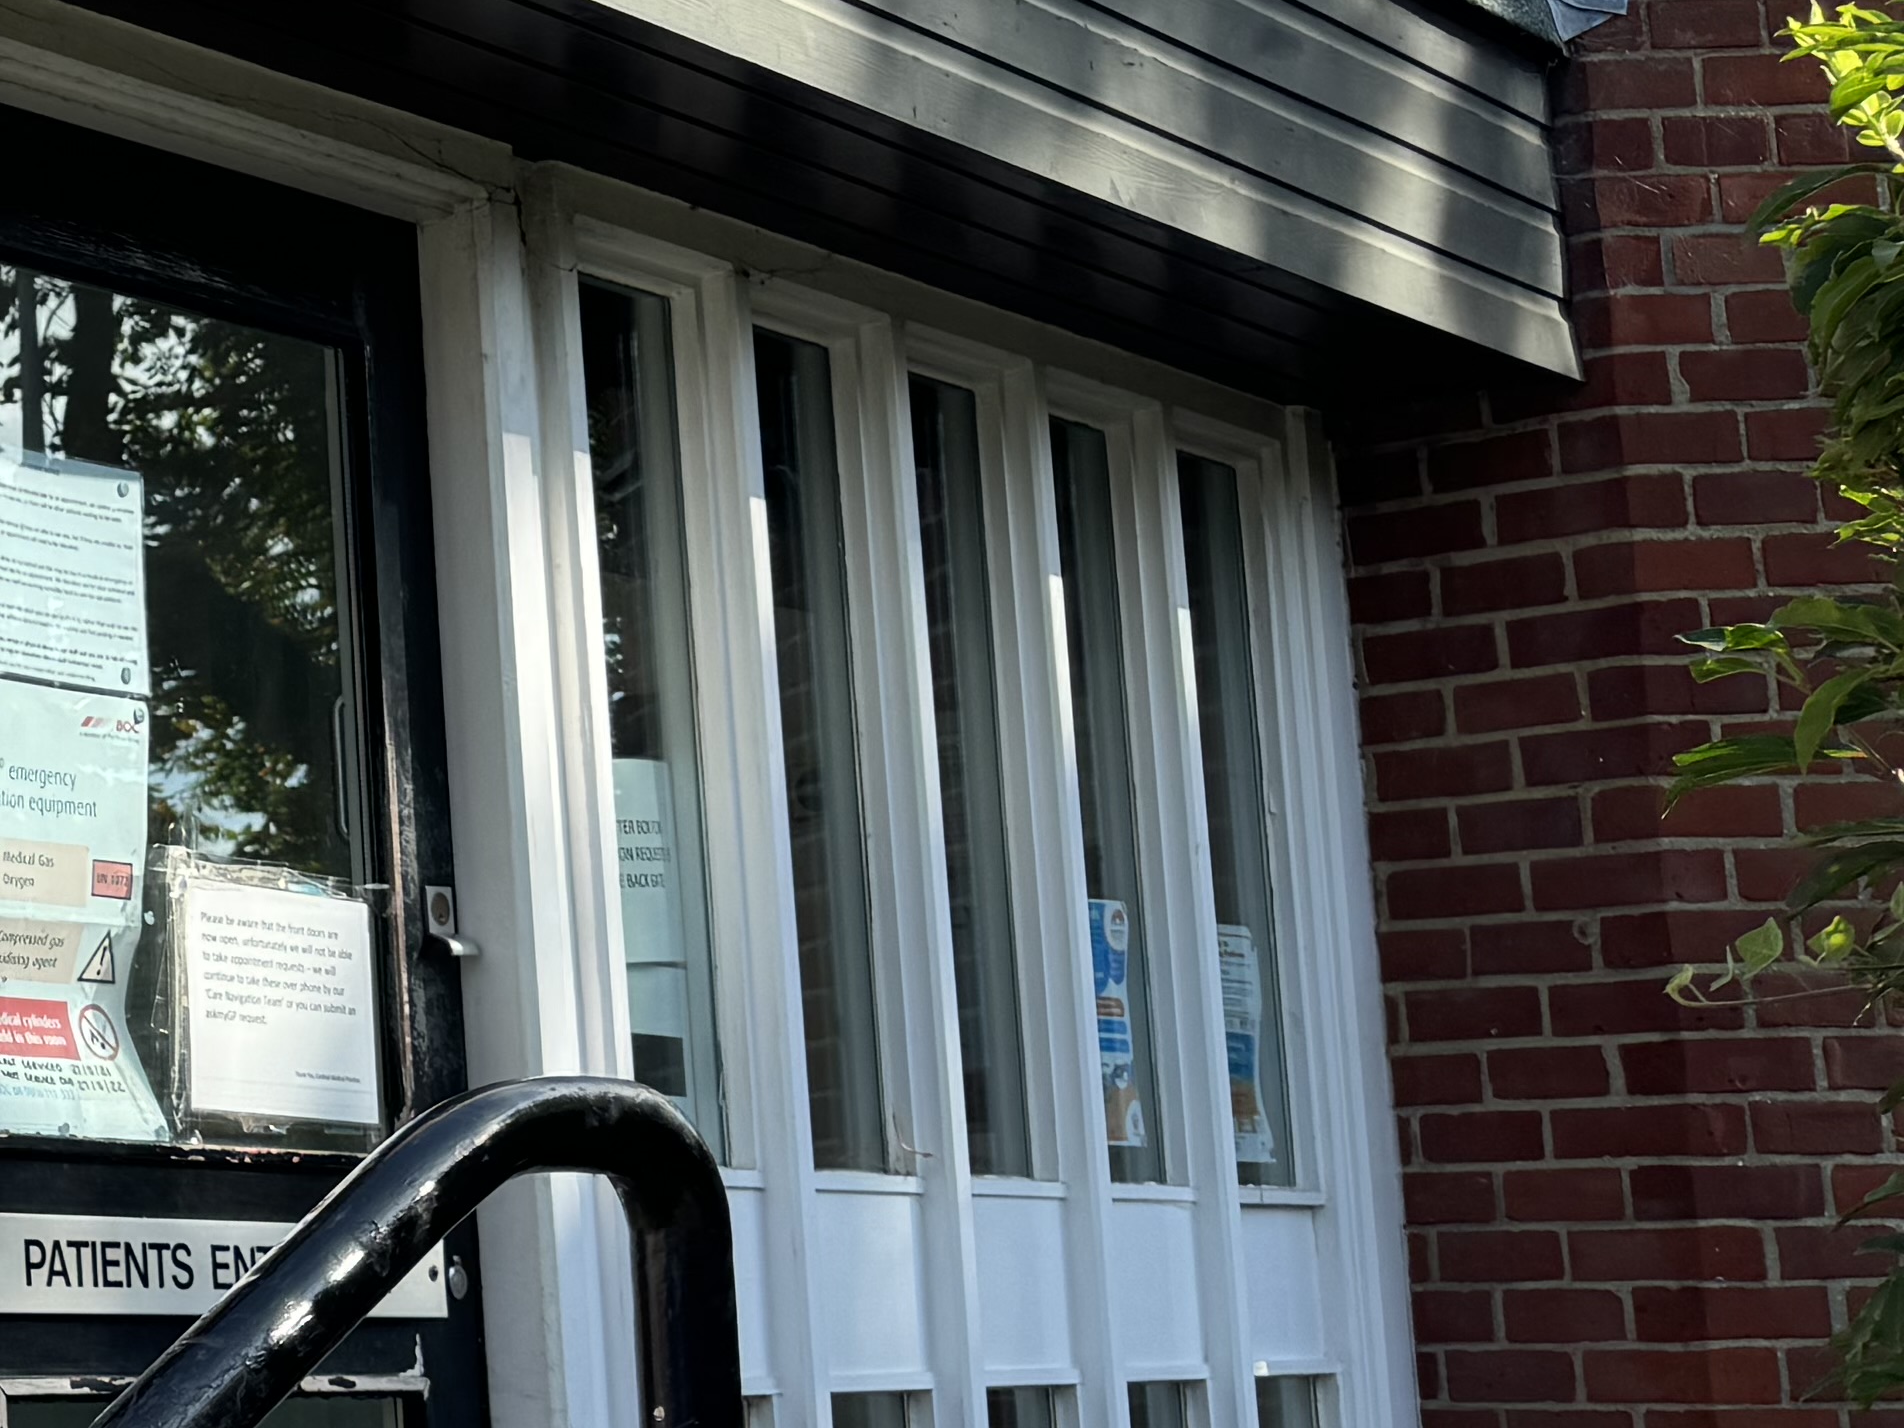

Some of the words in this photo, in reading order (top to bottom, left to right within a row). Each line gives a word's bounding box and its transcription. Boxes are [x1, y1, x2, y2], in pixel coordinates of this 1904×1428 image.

[9, 765, 76, 791] emergency
[29, 795, 97, 817] equipment
[38, 855, 54, 867] Gas
[200, 912, 223, 924] Please
[225, 915, 234, 925] be
[238, 919, 258, 929] aware
[261, 920, 273, 931] that
[276, 921, 286, 933] the
[288, 923, 304, 936] front
[307, 926, 325, 939] doors
[328, 931, 338, 940] are
[49, 937, 64, 949] gas
[202, 932, 216, 942] now
[290, 944, 299, 953] we
[302, 943, 312, 954] will
[315, 946, 325, 957] not
[328, 947, 336, 958] be
[338, 949, 352, 960] able
[203, 951, 210, 961] to
[212, 951, 228, 963] take
[231, 955, 273, 969] appointment
[276, 960, 305, 973] requests
[313, 966, 322, 975] we
[325, 965, 336, 976] will
[204, 971, 235, 982] continue
[237, 973, 244, 984] to
[246, 974, 260, 986] take
[262, 976, 281, 988] these
[283, 980, 297, 990] over
[300, 981, 321, 993] phone
[323, 984, 331, 996] by
[333, 987, 344, 996] our
[225, 989, 261, 1005] Navigation
[286, 997, 293, 1005] or
[296, 1000, 308, 1011] you
[310, 1002, 322, 1012] can
[324, 1003, 346, 1014] submit
[348, 1007, 356, 1015] an
[23, 1014, 61, 1029] cylinders
[15, 1031, 23, 1042] in
[24, 1031, 43, 1044] this
[44, 1034, 67, 1046] room
[23, 1238, 193, 1289] PATIENTS
